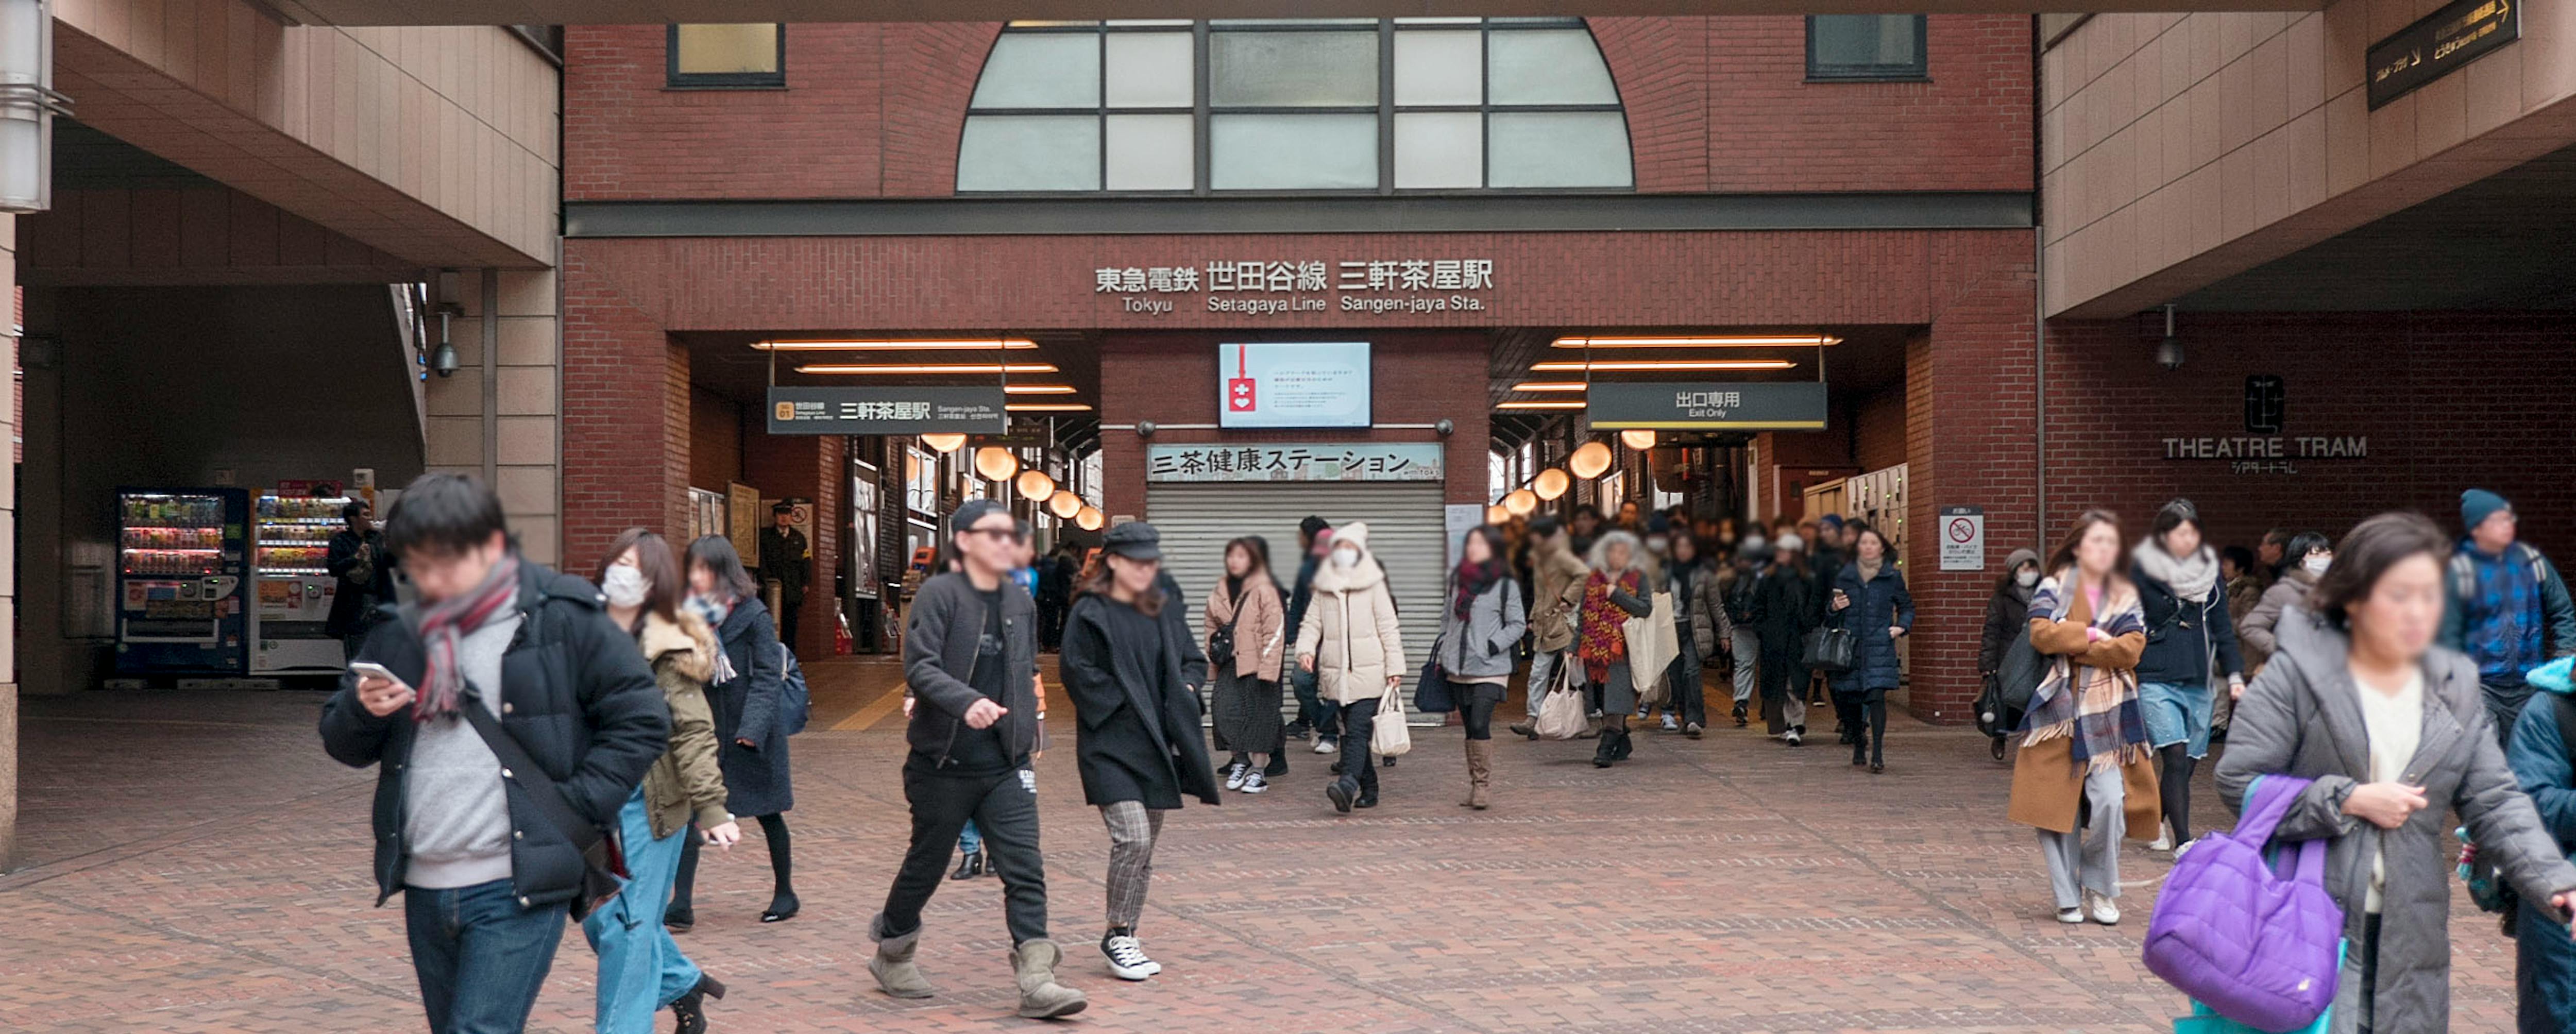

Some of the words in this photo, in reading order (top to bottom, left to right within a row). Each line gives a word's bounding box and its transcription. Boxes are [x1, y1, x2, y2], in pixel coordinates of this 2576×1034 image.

[1095, 266, 1199, 292] 東急電鉄
[1206, 260, 1328, 292] 世田谷線
[1337, 259, 1493, 291] 三軒茶屋駅
[1122, 297, 1173, 315] Tokyu
[1208, 296, 1288, 315] Setagaya
[1292, 296, 1327, 311] Line
[1341, 296, 1445, 314] Sangen-jaya
[1450, 295, 1485, 311] Sta.
[1676, 391, 1740, 408] 出口専用
[839, 401, 931, 420] 三軒茶屋駅
[1689, 408, 1705, 417] Exit
[1706, 408, 1727, 419] Only
[2162, 437, 2283, 459] THEATRE
[2295, 436, 2367, 457] TRAM
[1152, 447, 1410, 476] 三茶健康ステーション
